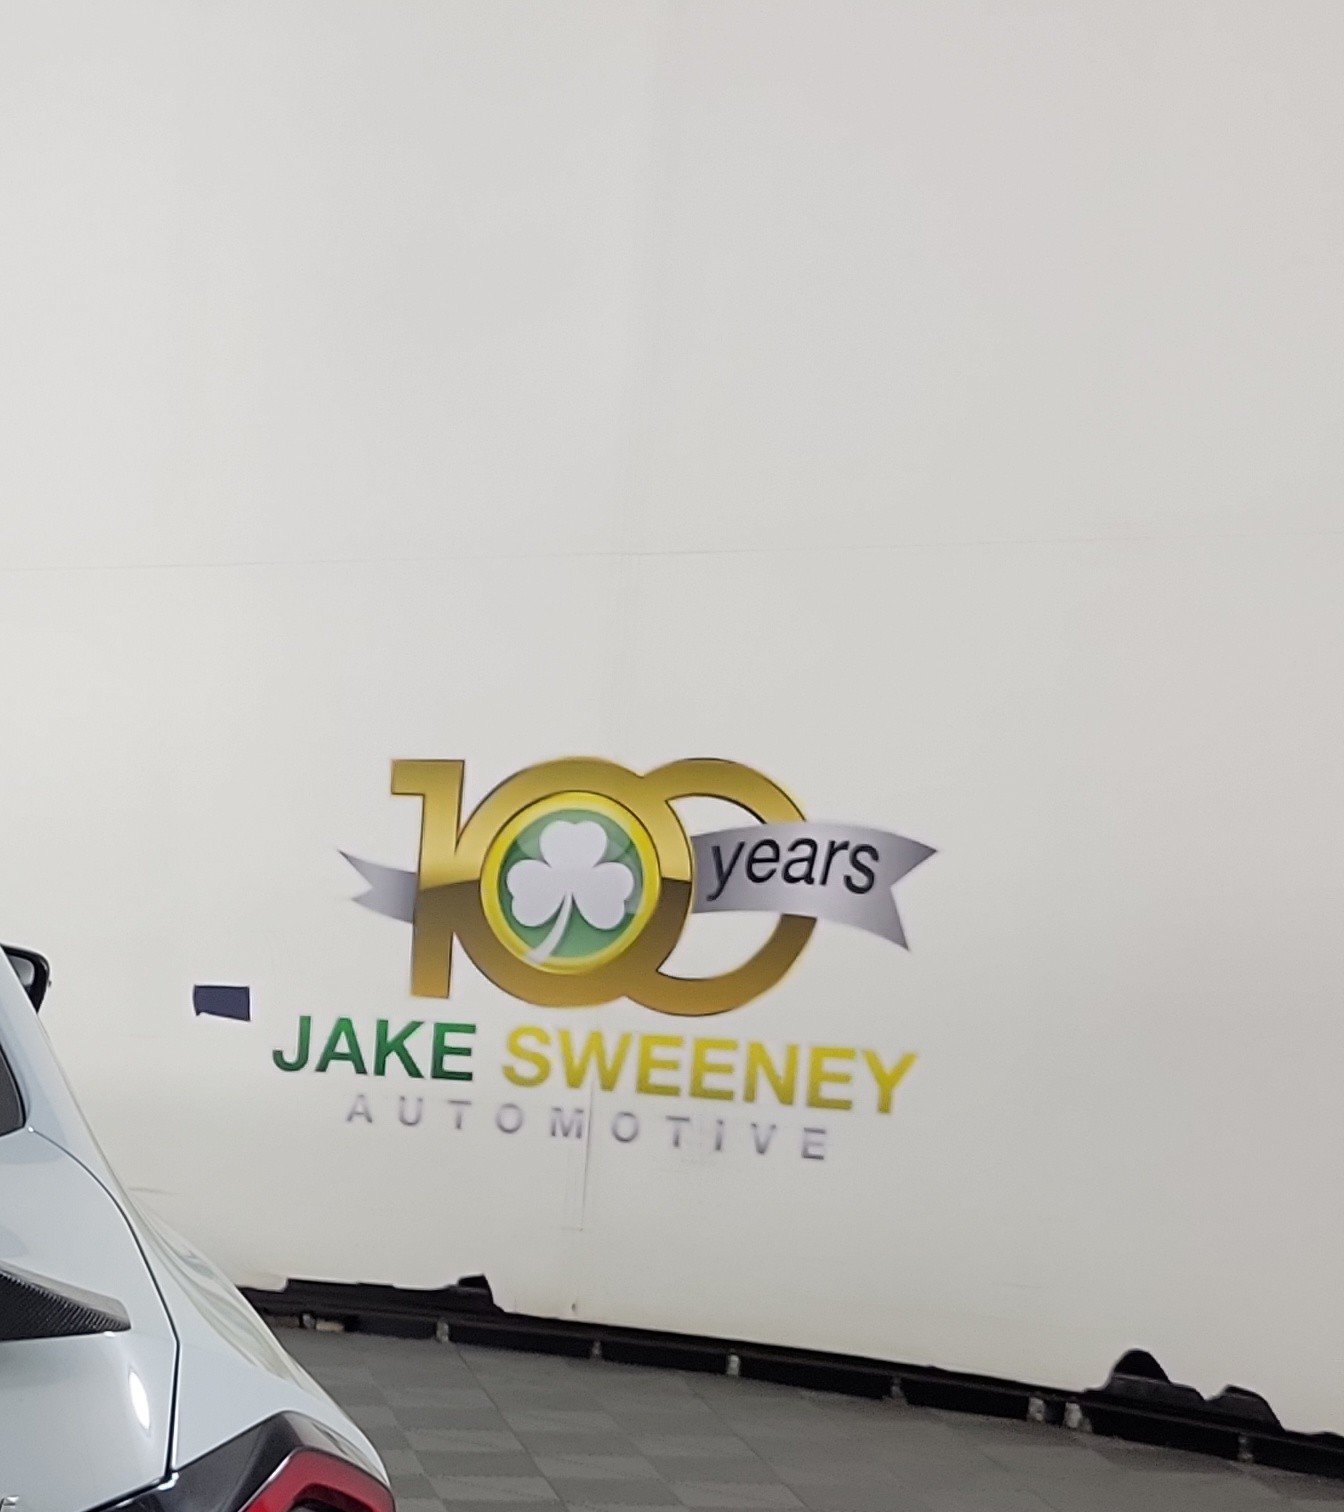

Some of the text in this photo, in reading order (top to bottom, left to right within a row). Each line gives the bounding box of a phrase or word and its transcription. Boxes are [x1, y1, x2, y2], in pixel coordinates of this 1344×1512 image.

[390, 757, 881, 1017] 100 years
[272, 1015, 919, 1115] JAKE SWEENEY
[346, 1093, 830, 1160] AUTOMOTIVE
